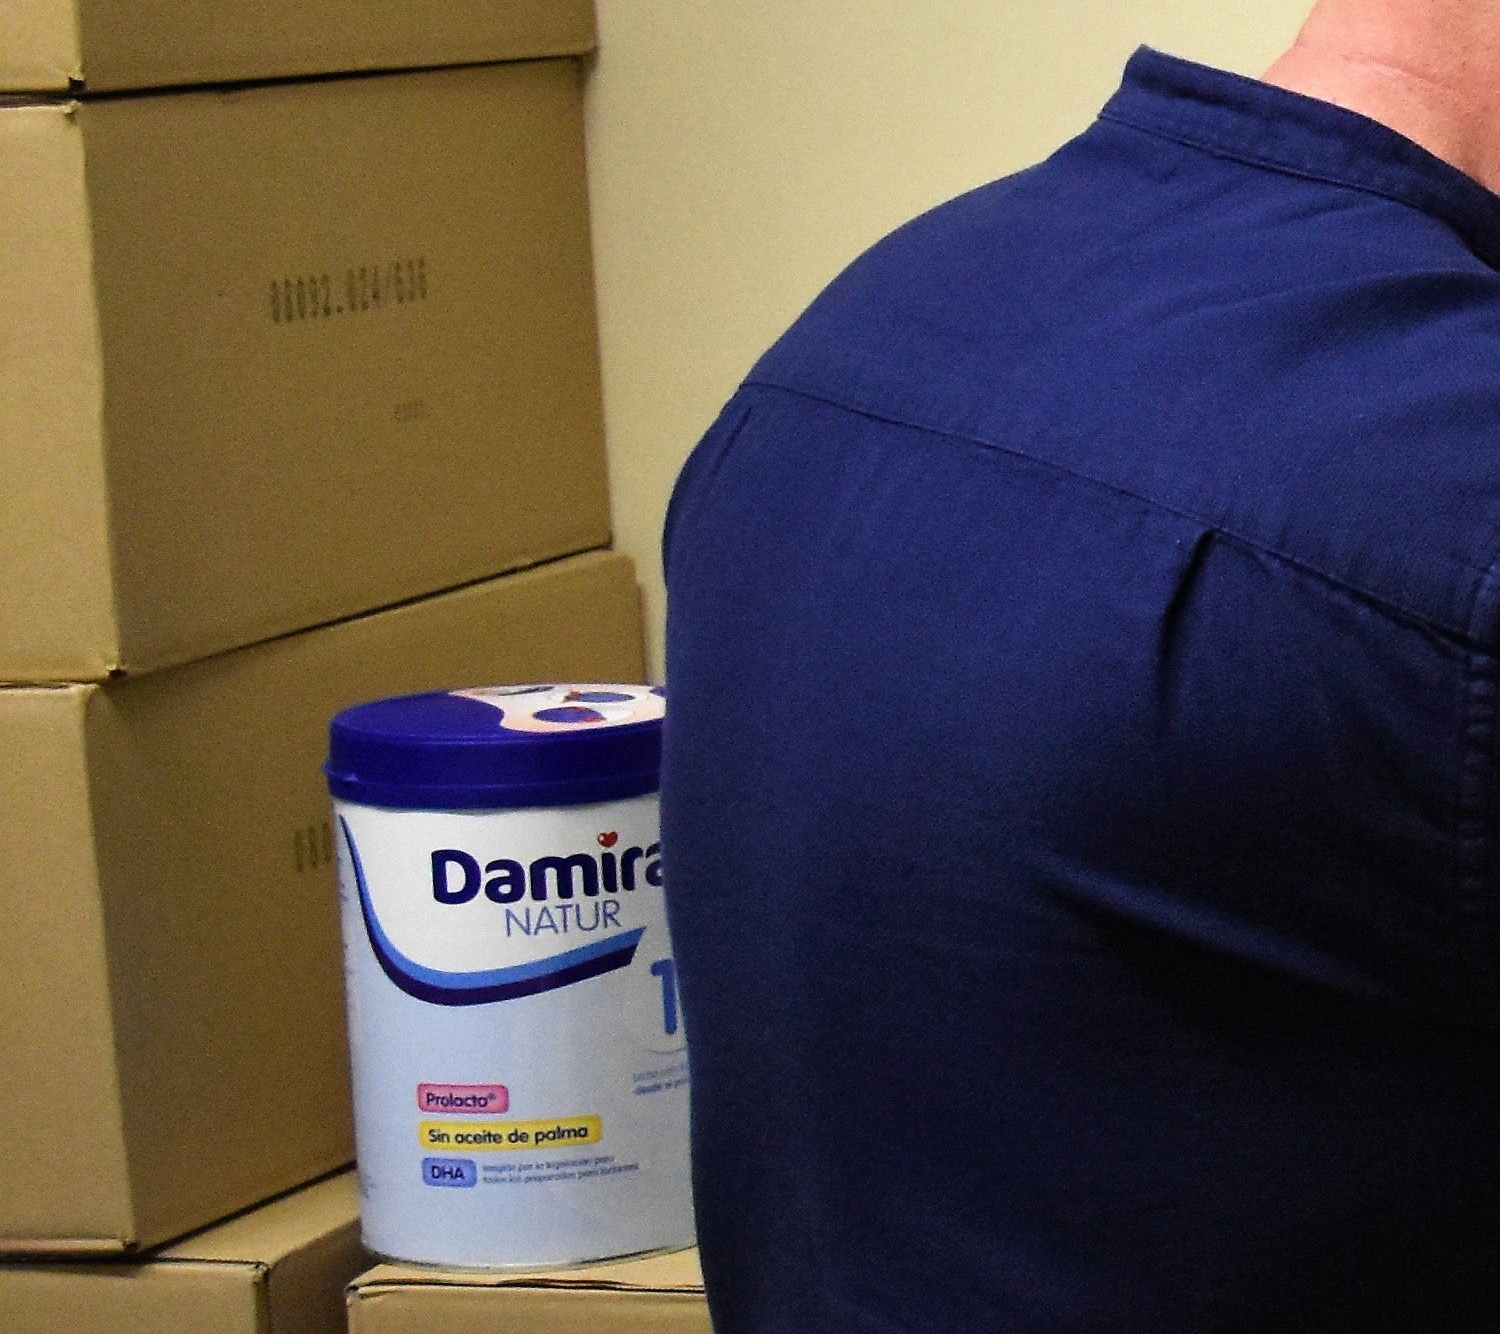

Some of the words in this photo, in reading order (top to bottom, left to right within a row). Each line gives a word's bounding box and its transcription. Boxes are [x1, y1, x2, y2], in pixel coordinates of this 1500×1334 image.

[504, 899, 622, 937] NATUR
[651, 959, 678, 1035] 1
[428, 1129, 450, 1143] Sin
[453, 1129, 503, 1145] aceite
[507, 1129, 529, 1144] de
[534, 1124, 588, 1146] palma
[431, 1165, 465, 1180] DHA
